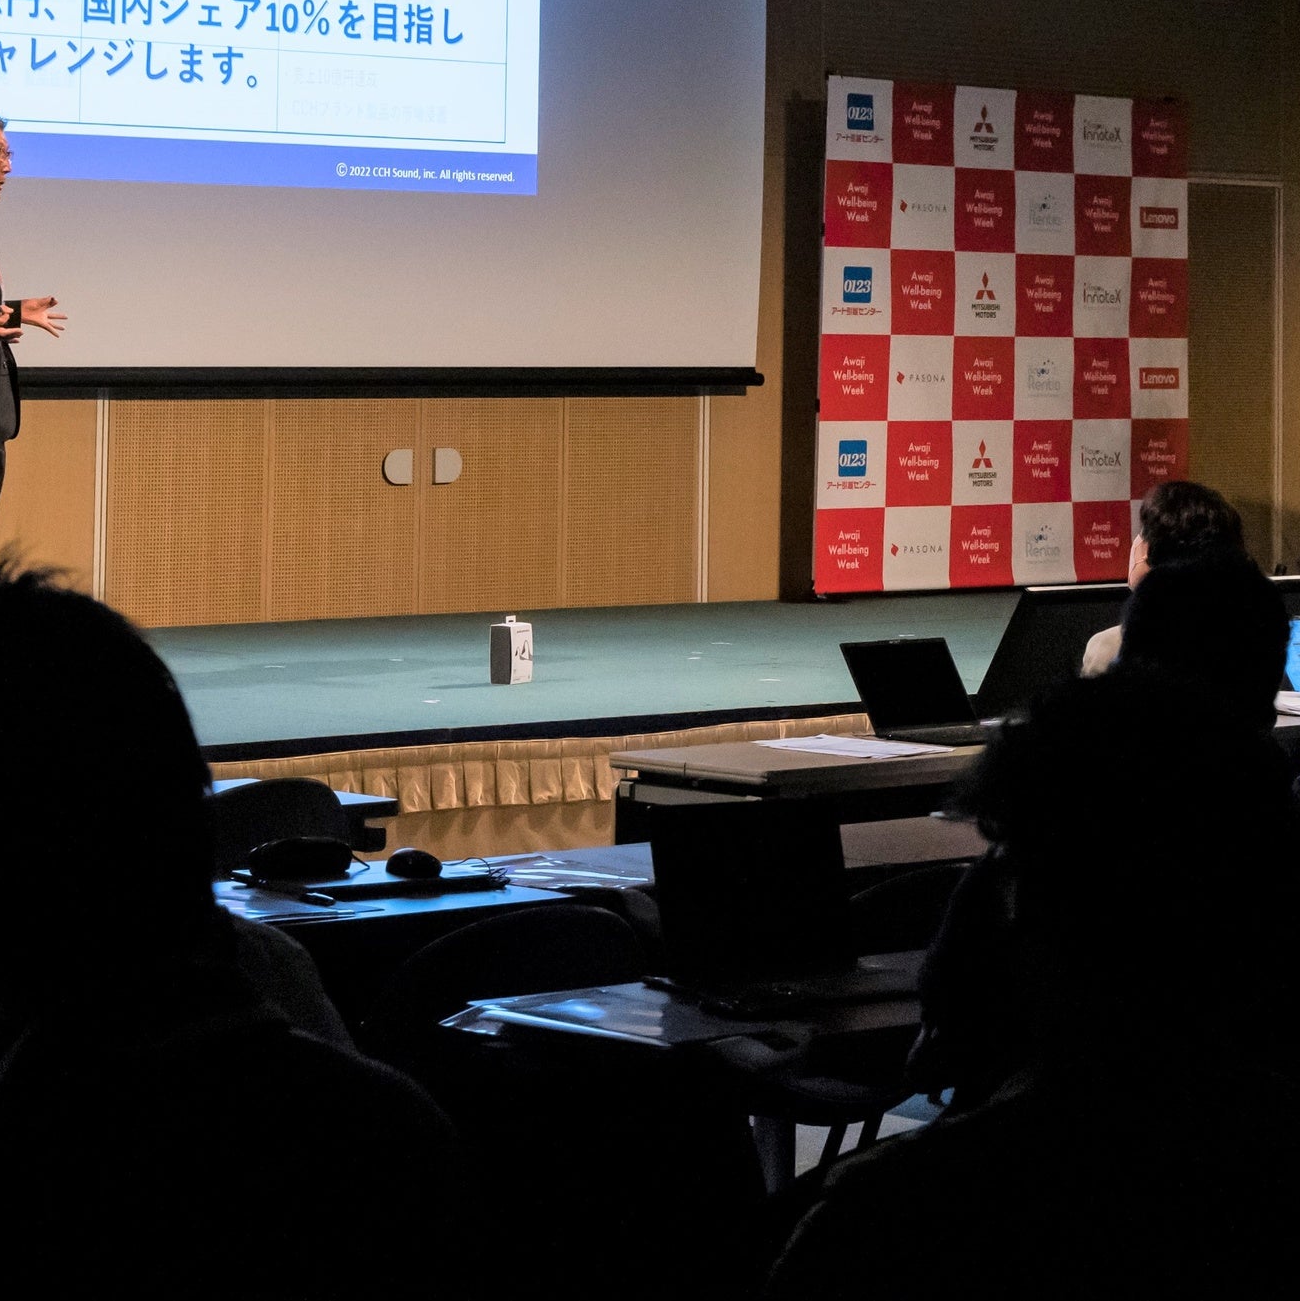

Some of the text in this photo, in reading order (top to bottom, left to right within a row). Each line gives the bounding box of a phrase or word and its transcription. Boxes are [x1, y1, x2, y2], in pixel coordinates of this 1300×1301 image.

[848, 107, 873, 120] 0123
[349, 166, 371, 177] 2022
[372, 167, 391, 178] CCH
[392, 168, 421, 180] Sound,
[440, 169, 451, 179] All
[452, 169, 476, 183] rights
[477, 171, 516, 183] reserved.
[838, 196, 877, 210] Well-being
[847, 211, 869, 222] Week
[911, 271, 933, 283] Awaji
[844, 280, 872, 293] 0123
[901, 285, 942, 298] Well-being
[910, 299, 932, 310] Week
[843, 356, 865, 368] Awaji
[973, 357, 994, 369] Awaji
[833, 370, 874, 383] Well-being
[964, 371, 1001, 384] Well-being
[1143, 372, 1175, 384] Lenovo
[842, 384, 865, 395] Week
[972, 385, 993, 395] Week
[908, 443, 930, 454] Awaji
[840, 453, 866, 467] 0123
[899, 457, 939, 468] Well-being
[907, 471, 929, 481] Week
[838, 531, 860, 542] Awaji
[971, 526, 992, 537] Awaji
[828, 545, 869, 556] Well-being
[903, 545, 943, 554] PASONA
[961, 540, 999, 552] Well-being
[837, 559, 859, 569] Week
[970, 554, 990, 564] Week
